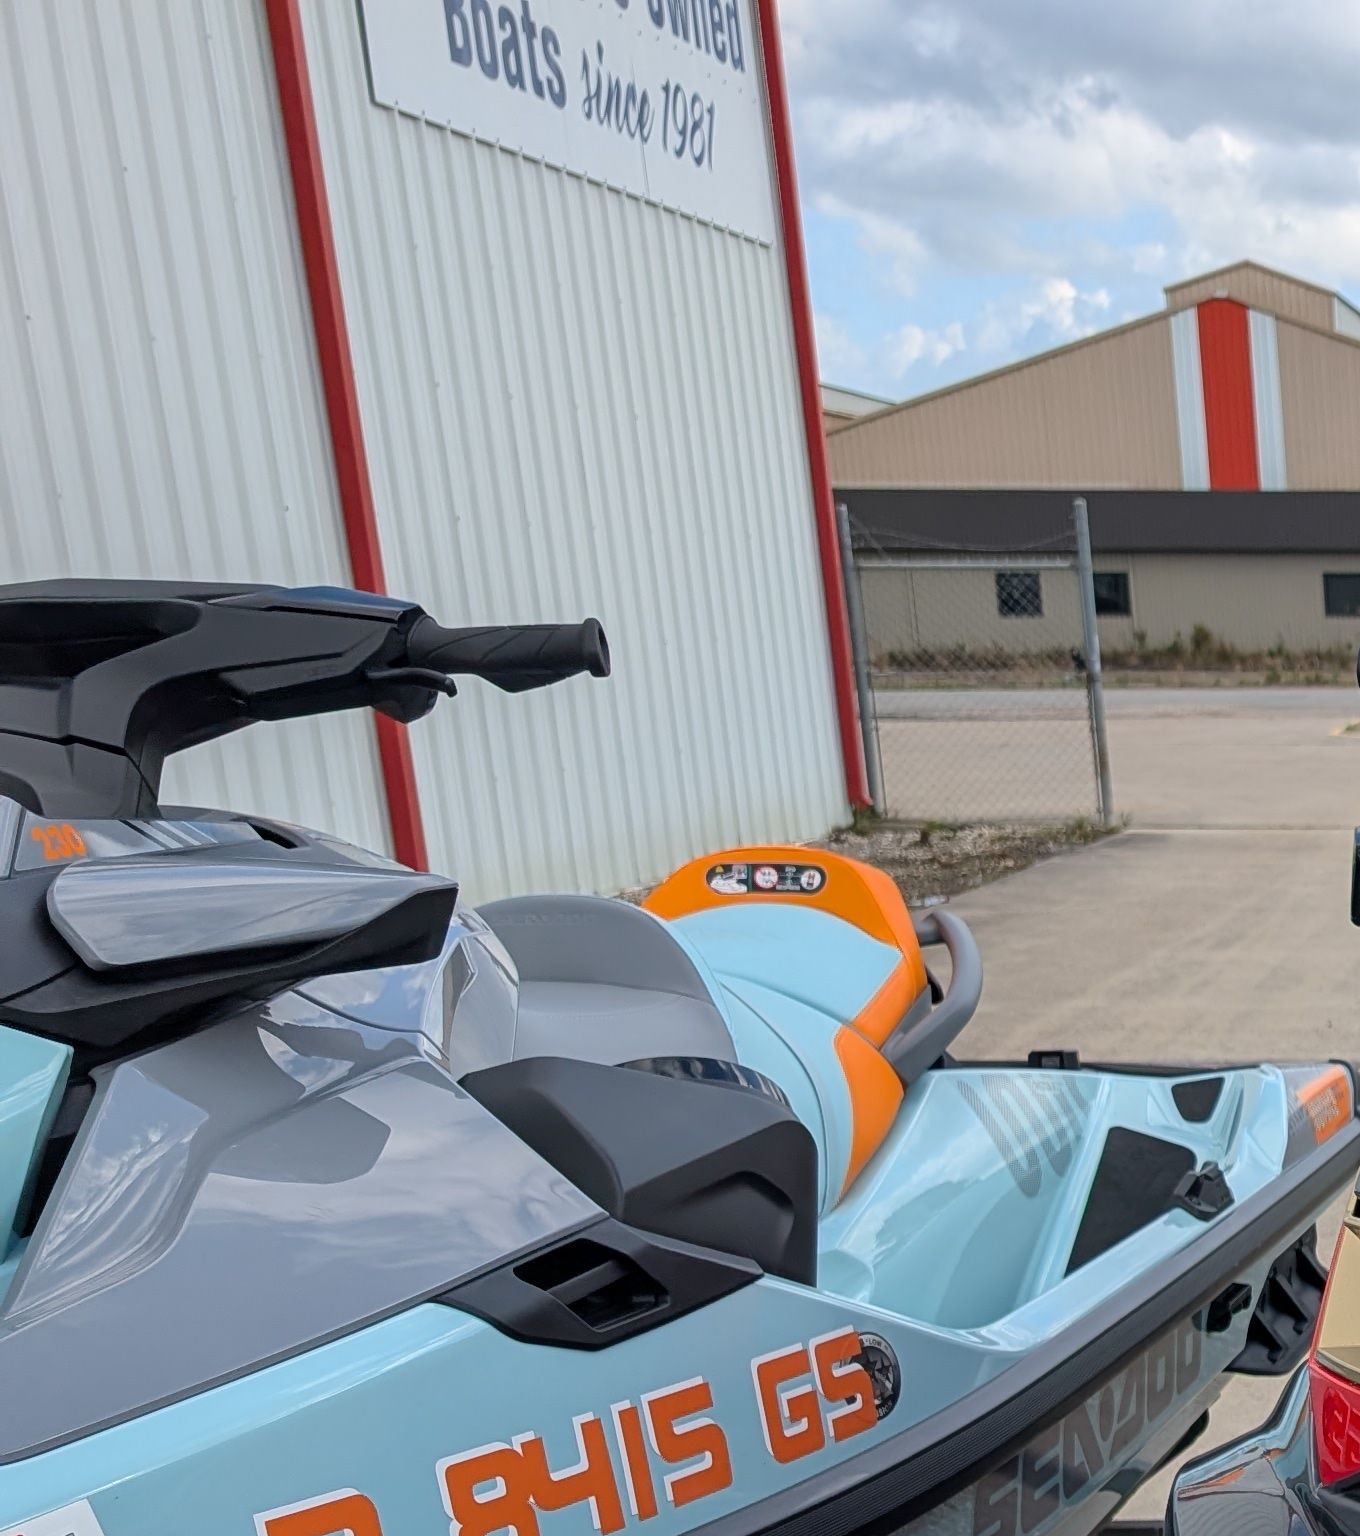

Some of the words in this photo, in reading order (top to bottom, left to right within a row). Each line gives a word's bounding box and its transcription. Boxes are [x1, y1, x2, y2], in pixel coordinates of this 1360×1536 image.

[444, 0, 567, 110] Boats
[580, 40, 655, 145] since
[661, 77, 715, 173] 1981
[751, 1325, 879, 1466] GS
